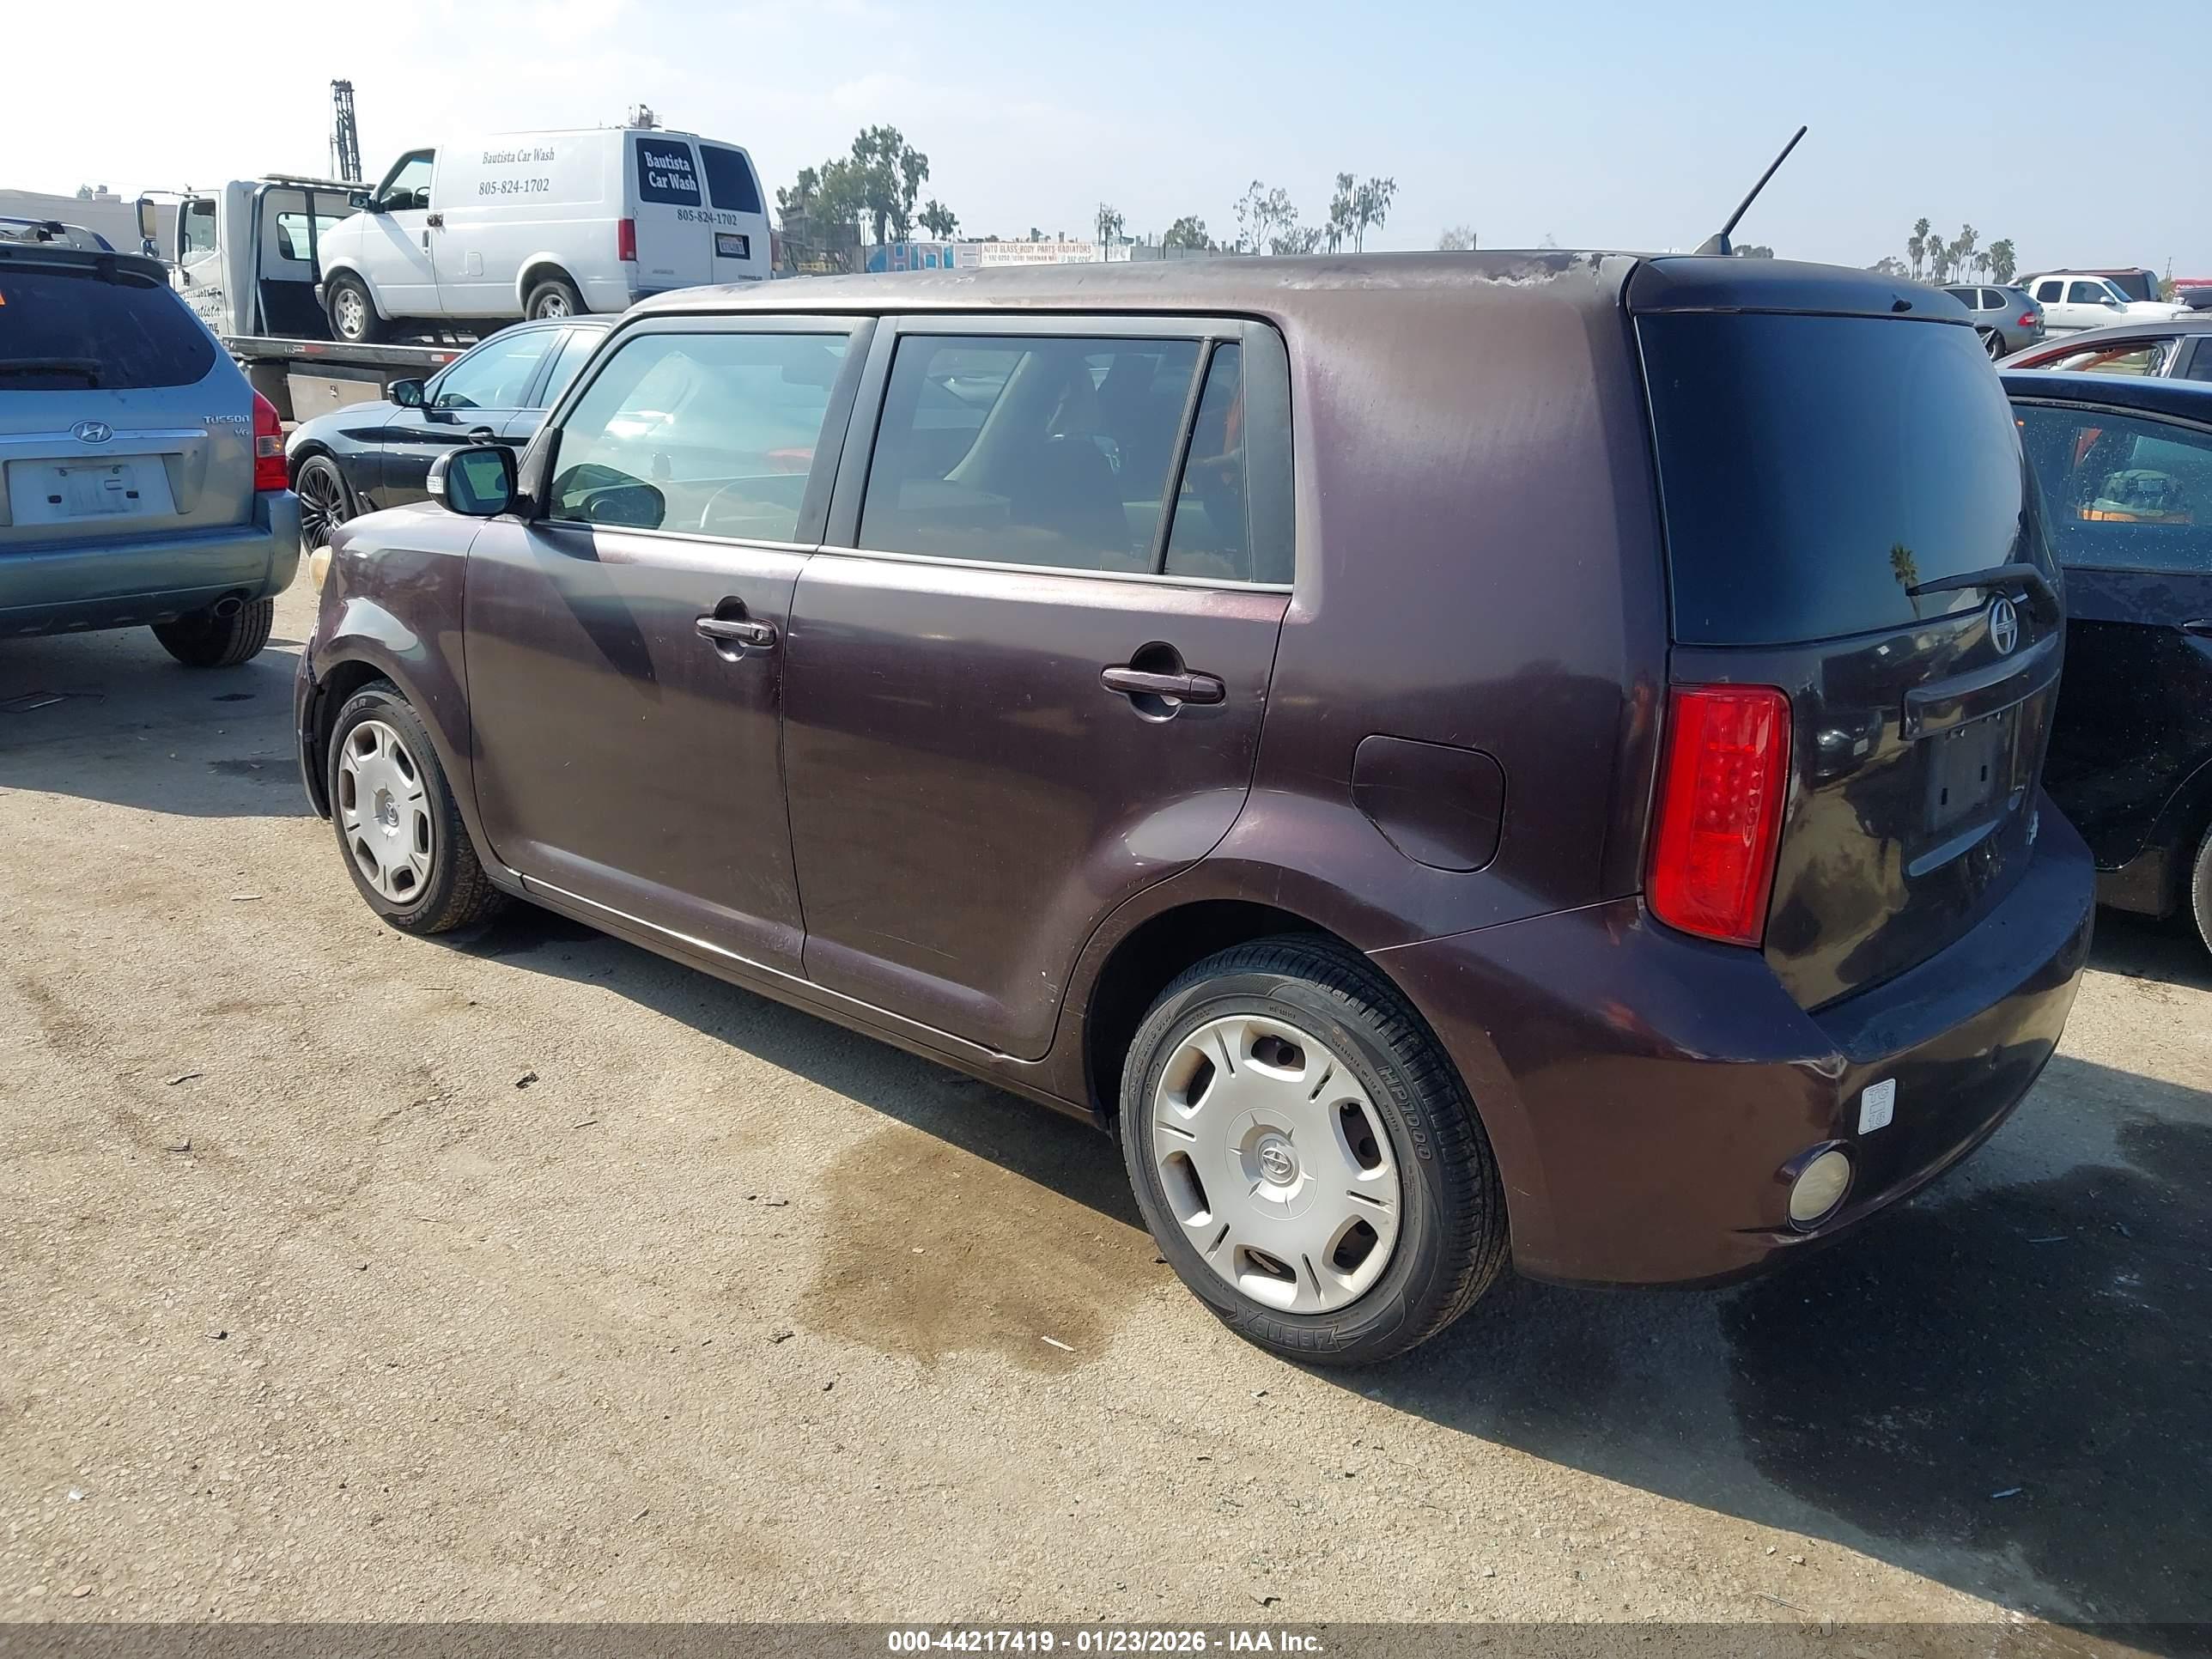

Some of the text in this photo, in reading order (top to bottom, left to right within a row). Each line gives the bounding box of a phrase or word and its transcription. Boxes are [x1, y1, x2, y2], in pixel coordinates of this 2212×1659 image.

[483, 147, 555, 164] Bautista Car Wash
[644, 151, 690, 172] Bautista
[478, 178, 550, 196] 805-824-1702
[648, 172, 697, 191] Car Wash
[677, 209, 738, 226] 805-824-1702
[983, 245, 998, 253] AUTO
[203, 415, 250, 424] TUCSON
[1376, 1065, 1432, 1160] HP1000
